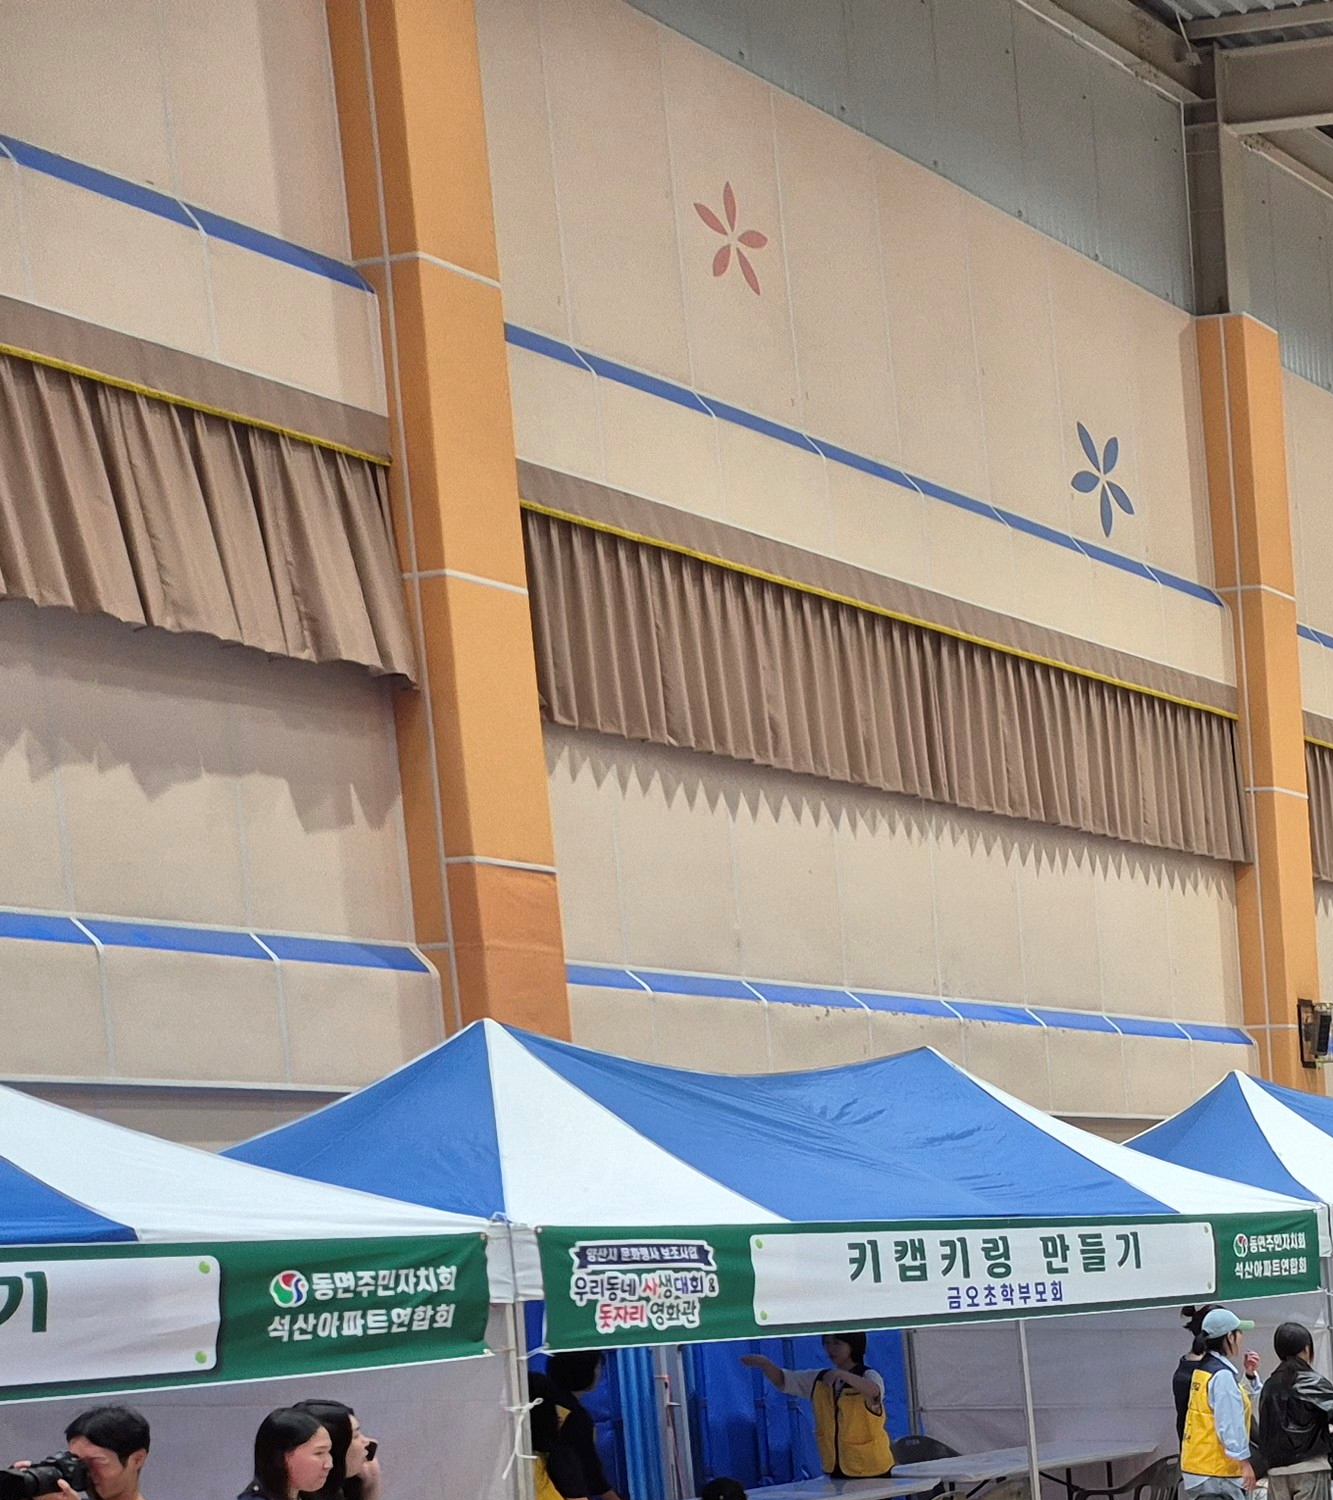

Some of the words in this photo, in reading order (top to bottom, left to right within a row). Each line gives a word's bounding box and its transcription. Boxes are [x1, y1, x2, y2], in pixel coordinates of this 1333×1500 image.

[847, 1237, 1014, 1283] 키캡키링
[1042, 1231, 1143, 1273] 만들기
[1249, 1232, 1306, 1254] 동면주민자치회
[1234, 1256, 1307, 1279] 석산아파트연합회
[312, 1264, 457, 1301] 동면주민자치회
[574, 1275, 637, 1302] 우리동네
[642, 1274, 704, 1299] 사생대회
[947, 1281, 1064, 1310] 금오초학부모회
[267, 1303, 456, 1342] 석산아파트연합회
[598, 1303, 645, 1329] 돗자리
[650, 1301, 697, 1326] 영화관
